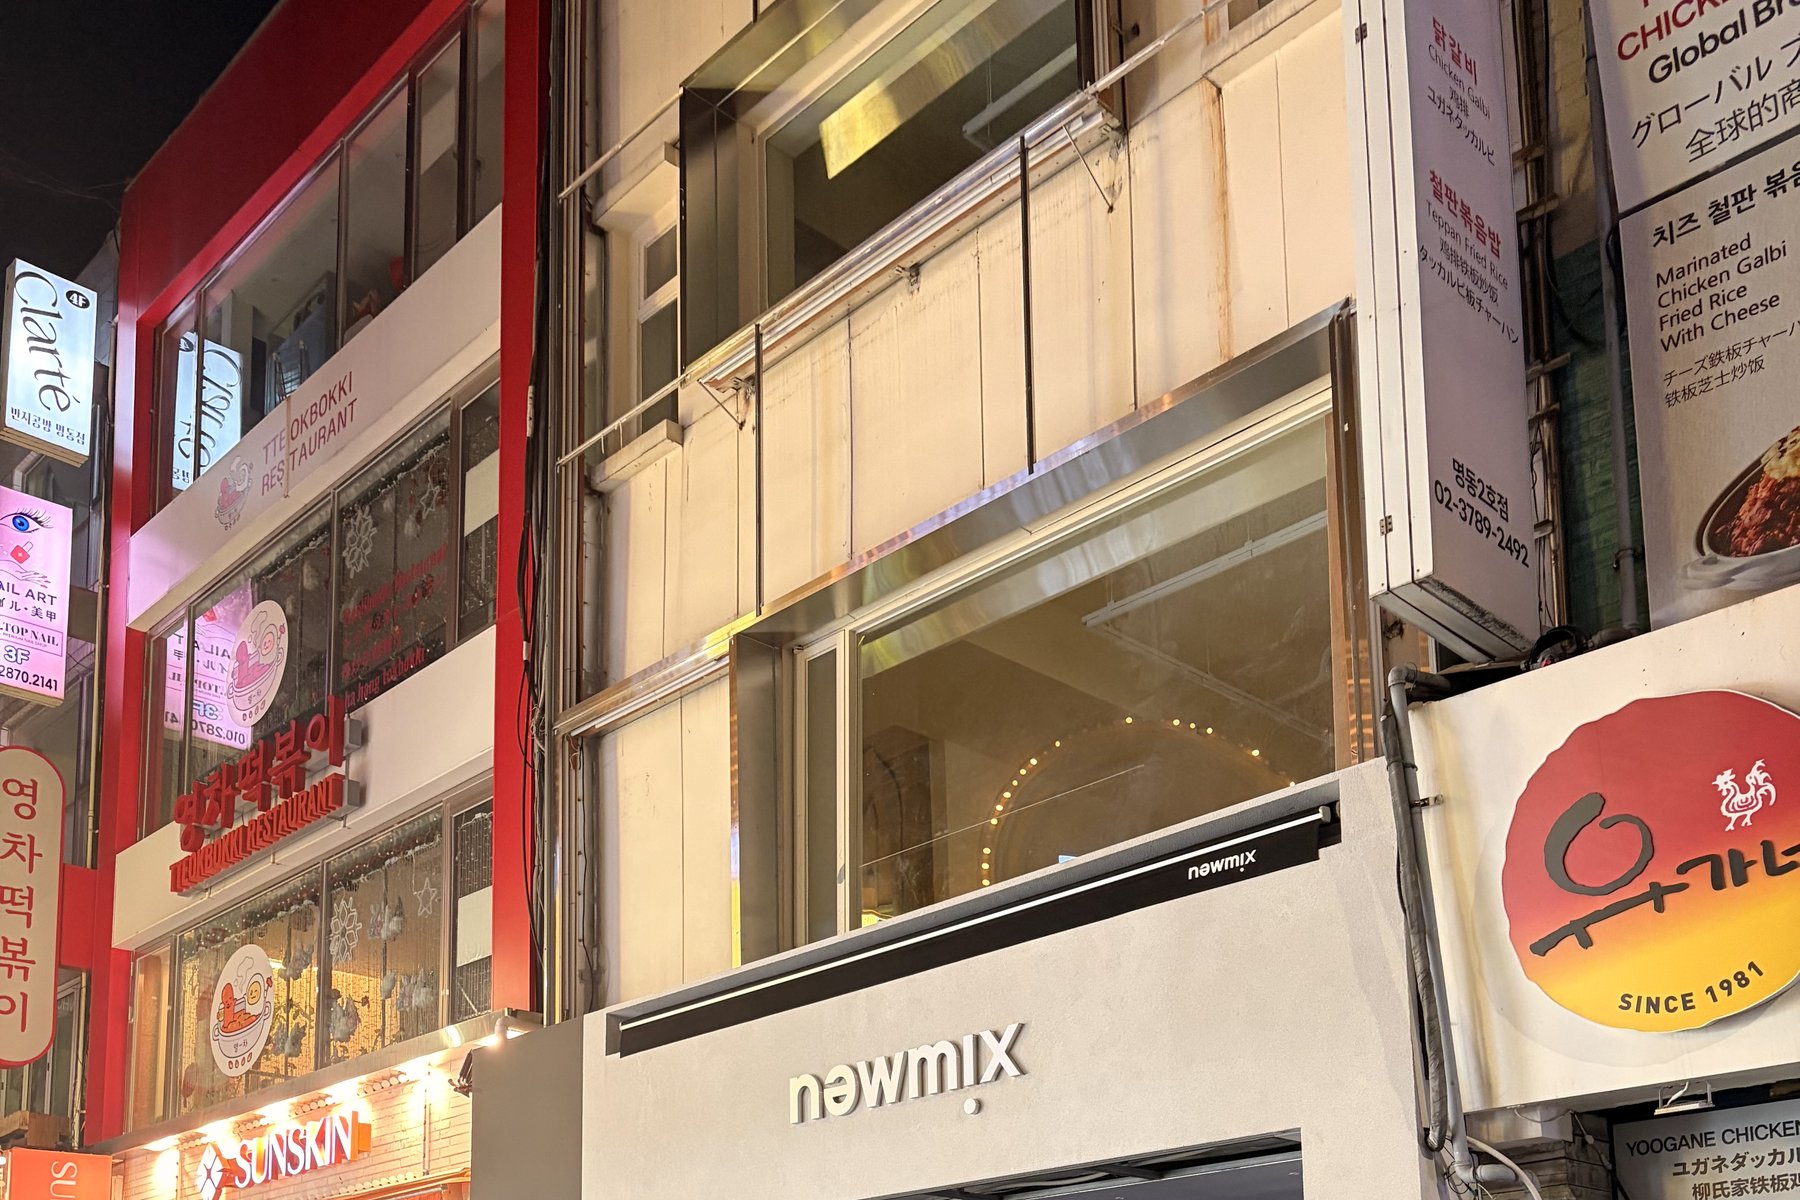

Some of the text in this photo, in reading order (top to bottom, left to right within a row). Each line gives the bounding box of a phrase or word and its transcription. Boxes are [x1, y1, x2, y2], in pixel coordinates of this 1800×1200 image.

[1432, 16, 1478, 86] 닭갈비
[1617, 0, 1730, 61] CHICK
[1648, 8, 1748, 83] Global
[1428, 44, 1490, 120] Chicken Galbi
[1632, 56, 1773, 149] グローバル
[1426, 199, 1509, 290] Teppan Fried Rice
[1429, 169, 1501, 259] 철판볶음밥
[1653, 212, 1701, 248] 치즈
[1708, 183, 1757, 226] 철판
[1656, 232, 1751, 289] Marinated
[1657, 240, 1787, 309] Chicken Galbi
[70, 292, 87, 309] 4F
[1660, 284, 1747, 332] Fried Rice
[1660, 294, 1780, 353] With Cheese
[14, 271, 81, 412] Clarté
[11, 407, 85, 445] 반지공방 명동점
[261, 398, 358, 496] RESTAURANT
[1434, 479, 1530, 568] 02-3789-2492
[1452, 458, 1508, 523] 명동2호점
[25, 589, 57, 605] ART
[4, 645, 30, 665] 3F
[173, 694, 345, 852] 영차떡볶이
[248, 773, 345, 852] RESTAURANT
[0, 778, 43, 1032] 영차떡볶이
[1618, 960, 1764, 1014] SINCE 1981
[234, 1111, 357, 1189] SUNSKIN
[1626, 1131, 1716, 1157] YOOGANE
